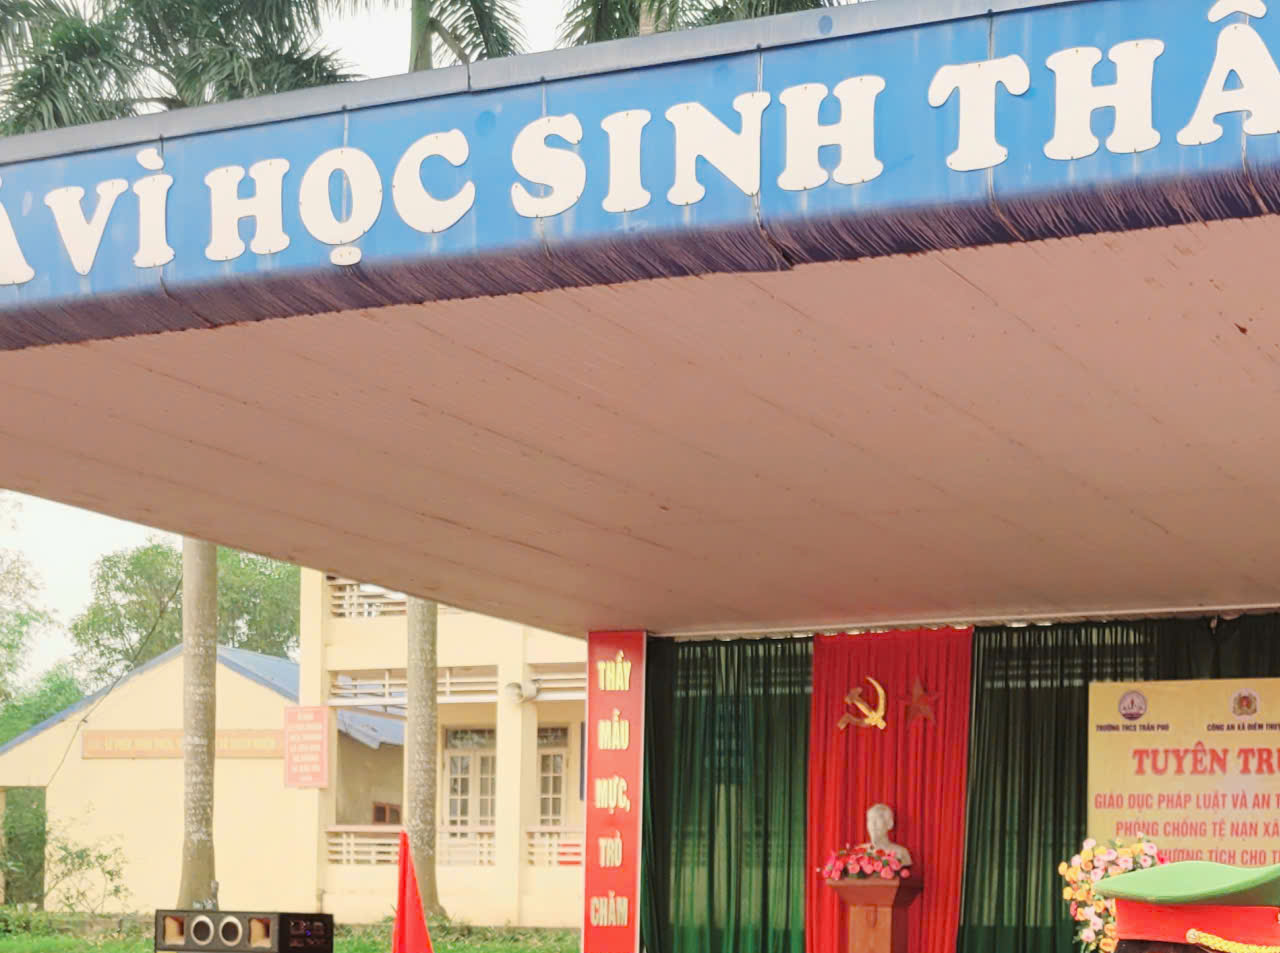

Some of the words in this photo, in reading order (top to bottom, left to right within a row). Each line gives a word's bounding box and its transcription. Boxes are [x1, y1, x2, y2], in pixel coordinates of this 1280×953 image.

[43, 147, 175, 276] VÌ
[204, 129, 476, 266] HỌC
[510, 75, 887, 219] SINH
[1132, 740, 1229, 776] TUYÊN
[1231, 789, 1248, 809] VÀ
[1252, 792, 1271, 809] AN
[1241, 849, 1266, 865] CHO
